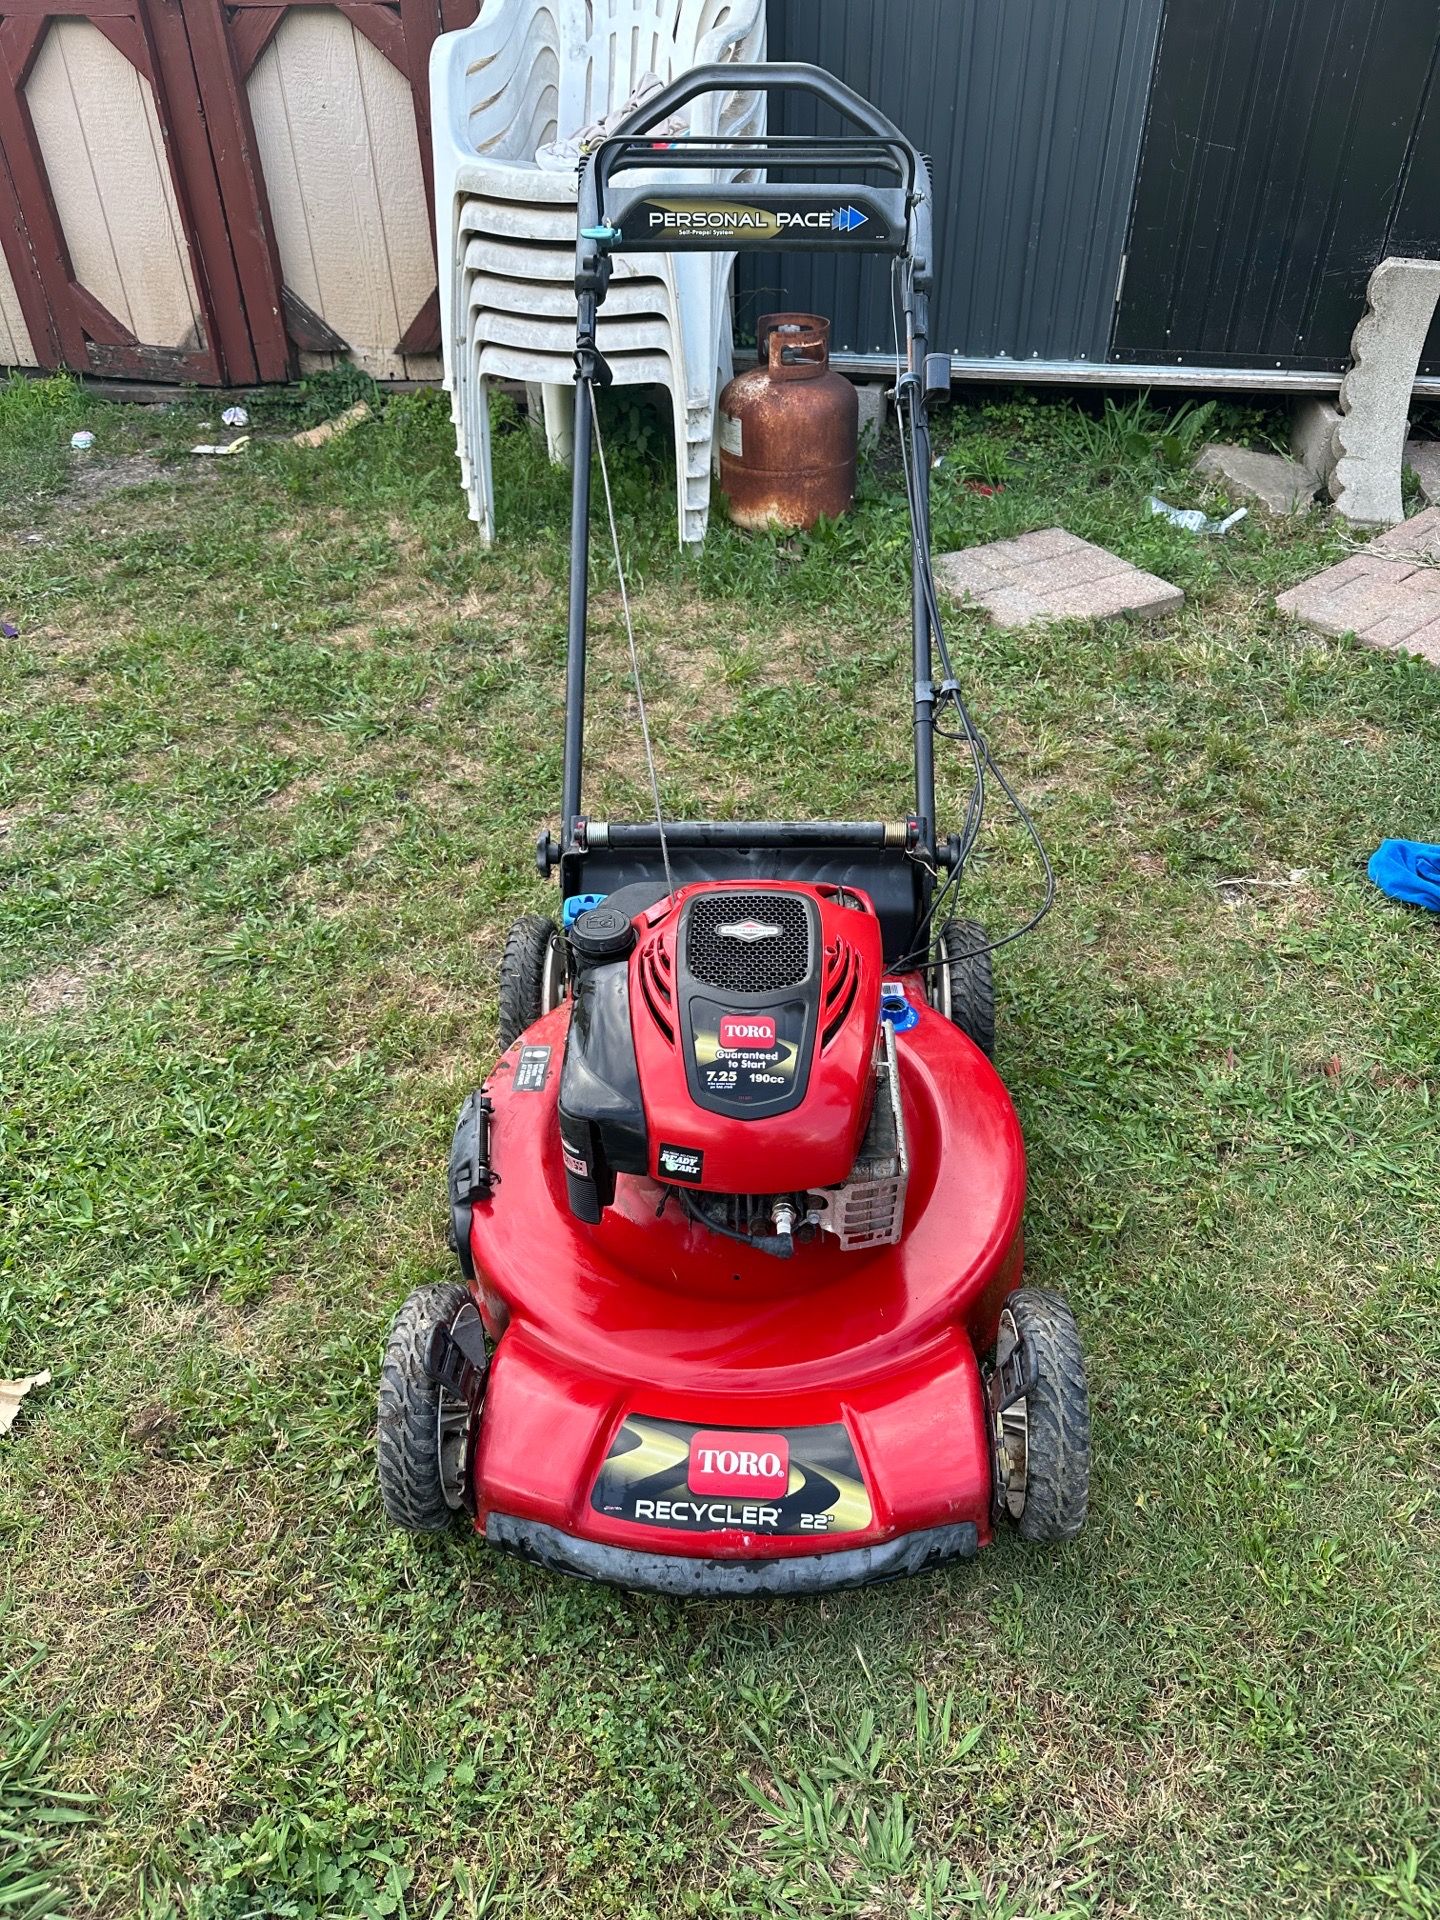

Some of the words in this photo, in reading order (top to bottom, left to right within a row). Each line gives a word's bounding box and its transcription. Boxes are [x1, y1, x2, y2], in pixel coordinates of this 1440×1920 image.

[649, 212, 767, 227] PERSONAL
[776, 212, 830, 227] PACE
[725, 1025, 771, 1038] TORO
[716, 1051, 778, 1060] Guaranteed
[728, 1060, 738, 1068] to
[741, 1060, 766, 1069] Start
[706, 1071, 738, 1082] 7.25
[749, 1073, 785, 1084] 190cc
[660, 1153, 698, 1166] READY
[665, 1162, 700, 1174] TART
[698, 1449, 784, 1477] TORO
[635, 1500, 780, 1527] RECYCLER
[800, 1514, 834, 1530] 22"
